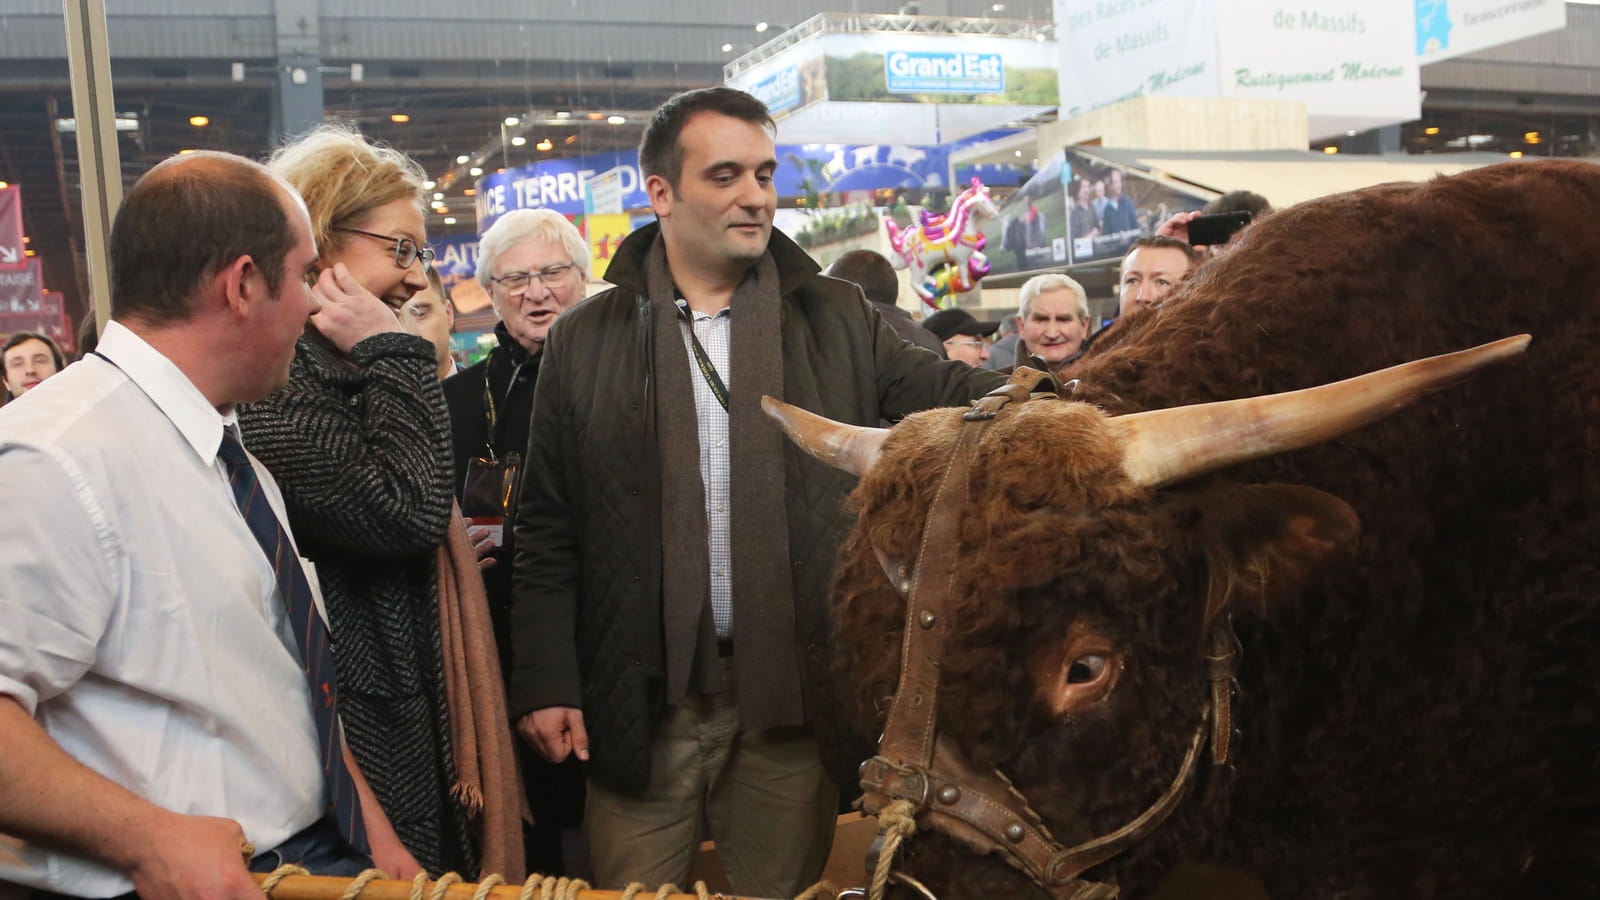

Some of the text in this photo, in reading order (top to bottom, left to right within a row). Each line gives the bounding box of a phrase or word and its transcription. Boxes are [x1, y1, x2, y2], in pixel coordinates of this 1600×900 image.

[1273, 9, 1366, 33] de Massifs
[889, 53, 1000, 78] Grand Est
[1235, 61, 1403, 91] Rustiquement Moderne
